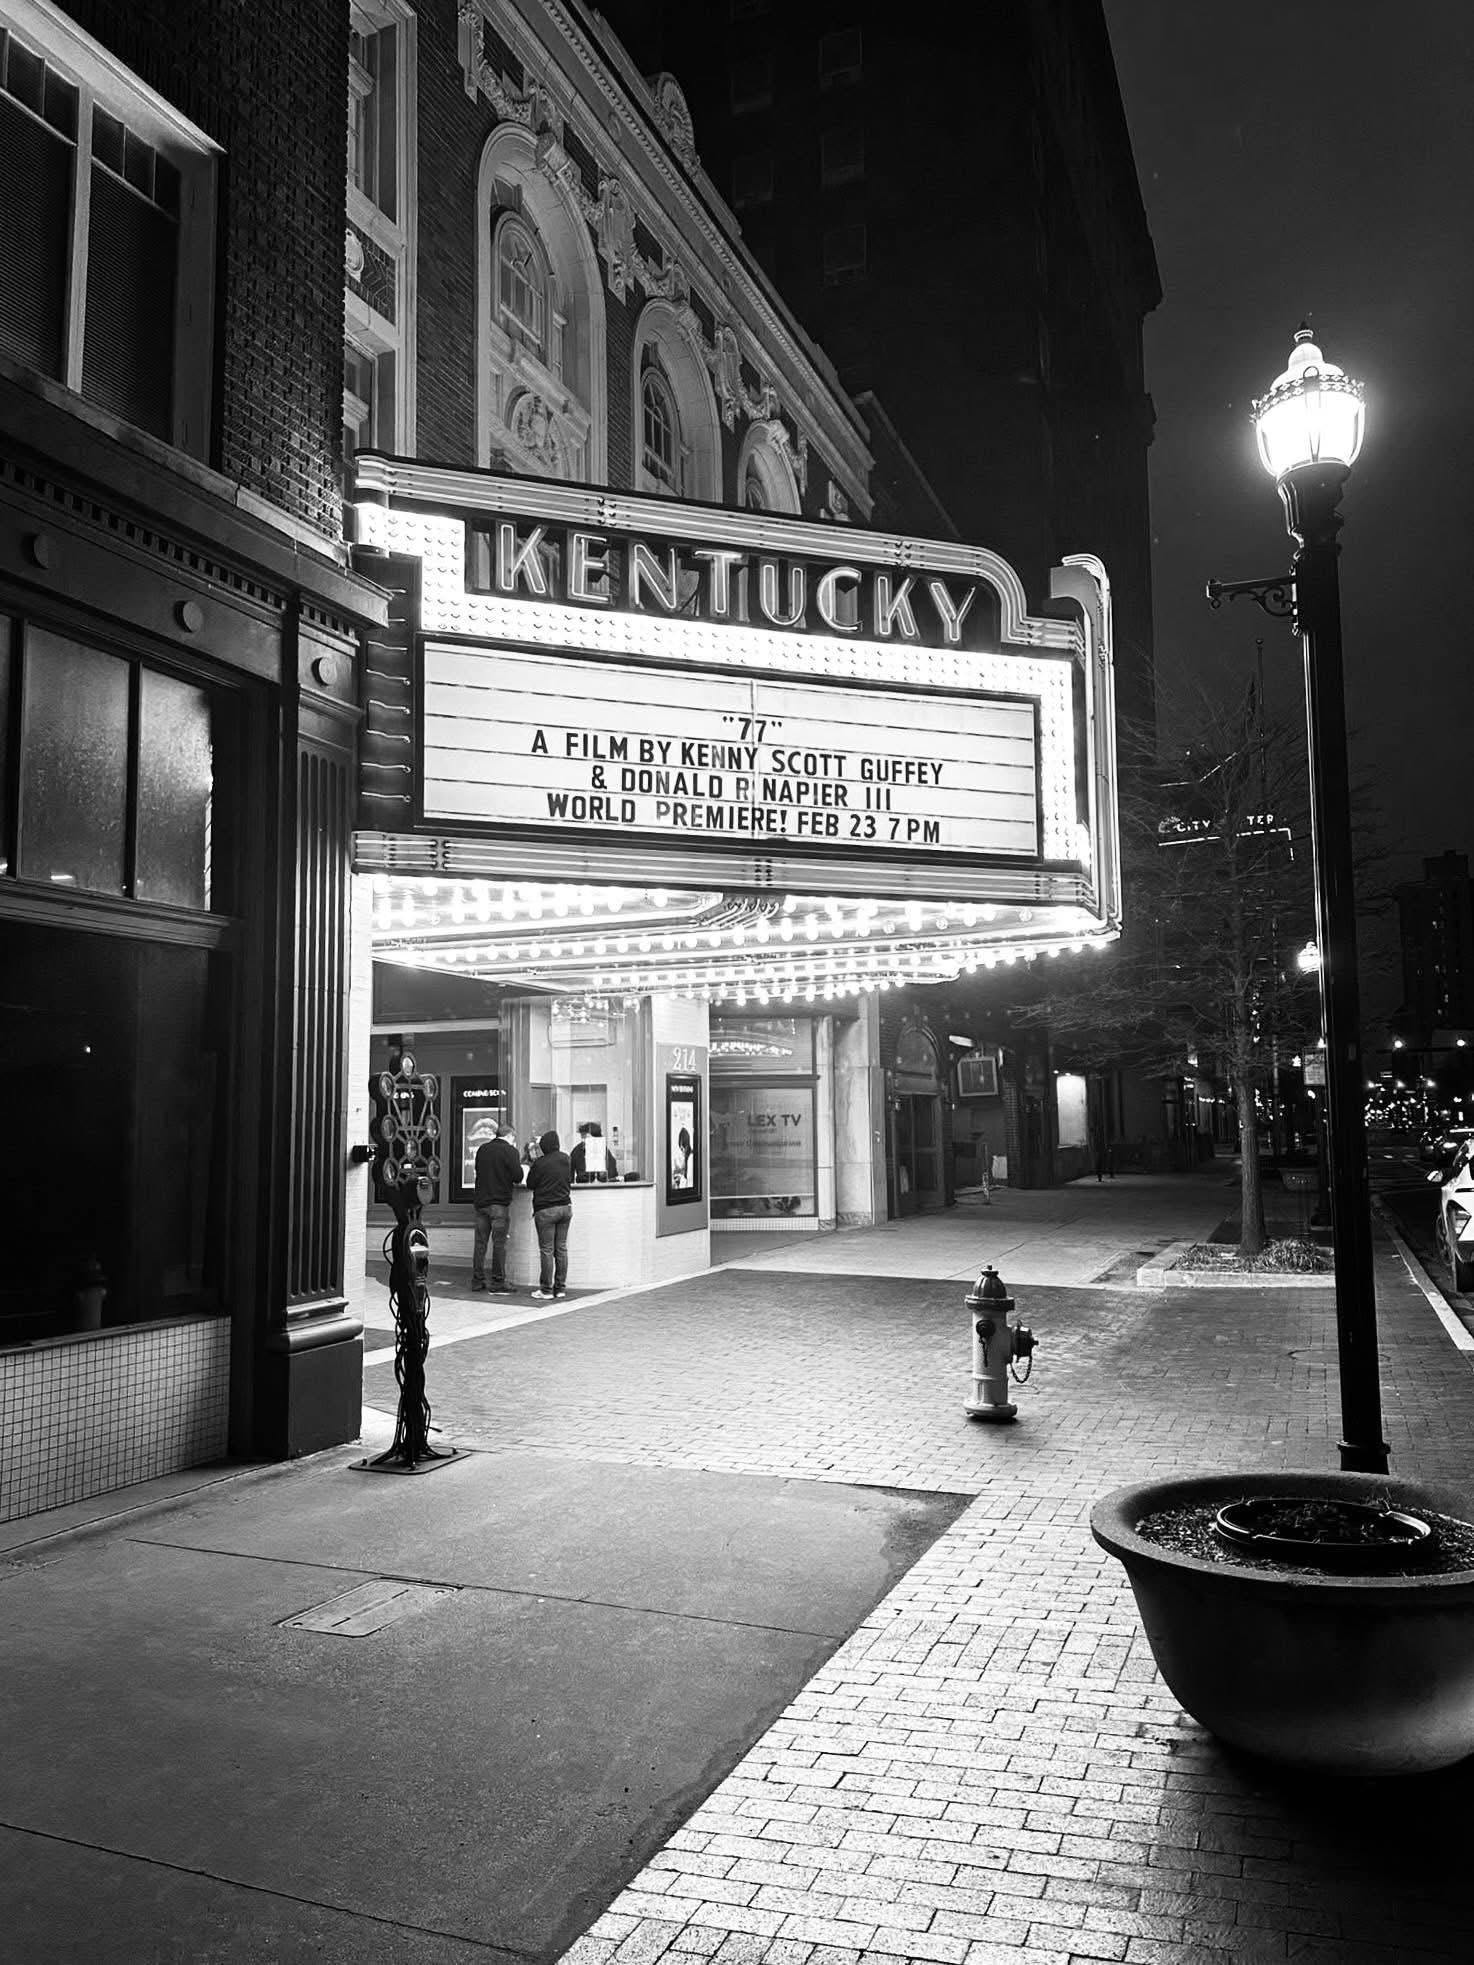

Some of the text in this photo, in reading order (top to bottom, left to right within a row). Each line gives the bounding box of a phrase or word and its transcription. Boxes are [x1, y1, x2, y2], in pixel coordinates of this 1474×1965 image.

[496, 520, 977, 643] KENTUCKY
[531, 729, 943, 785] A FILM BY KENNY SCOTT GUFFEY
[591, 765, 891, 811] & DONALD R NAPIER III
[547, 792, 941, 844] WORLD PREMIERE! FEB 23 7 PM
[672, 1047, 697, 1072] 214
[747, 1114, 802, 1127] LEX TV
